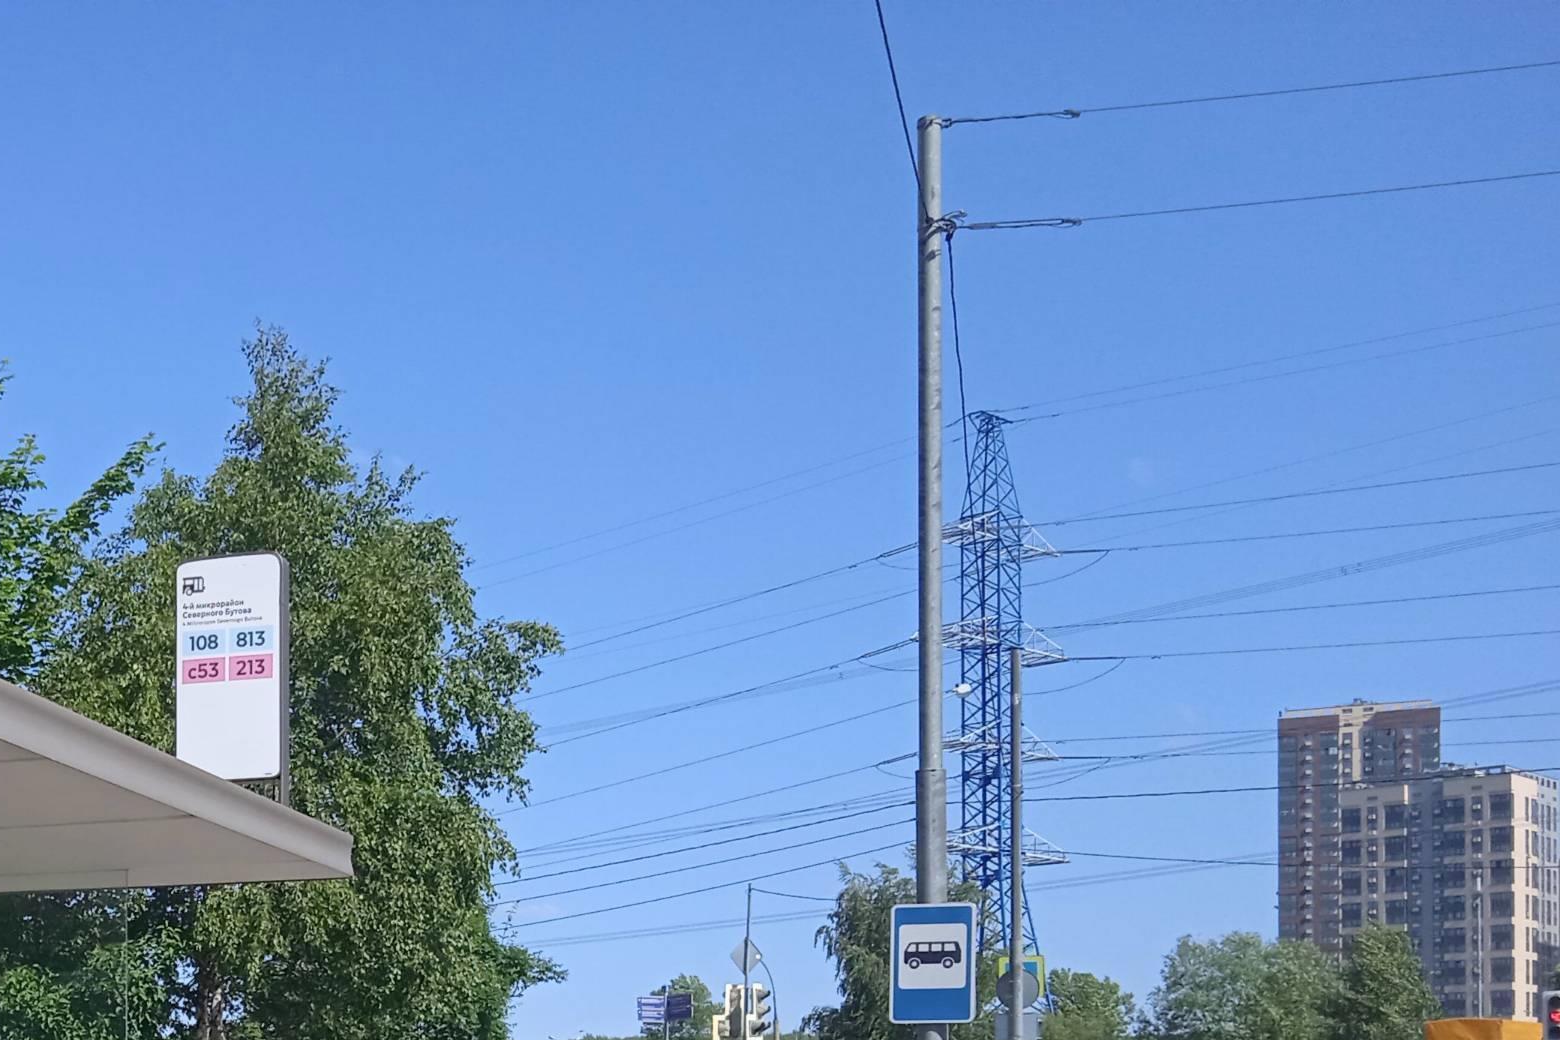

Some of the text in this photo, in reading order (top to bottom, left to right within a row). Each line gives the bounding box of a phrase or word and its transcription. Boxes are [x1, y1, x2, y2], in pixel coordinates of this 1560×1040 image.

[182, 607, 252, 619] Северного Бутова
[196, 599, 245, 610] микрорайон
[189, 634, 219, 651] 108
[236, 631, 266, 648] 813
[236, 659, 266, 676] 213
